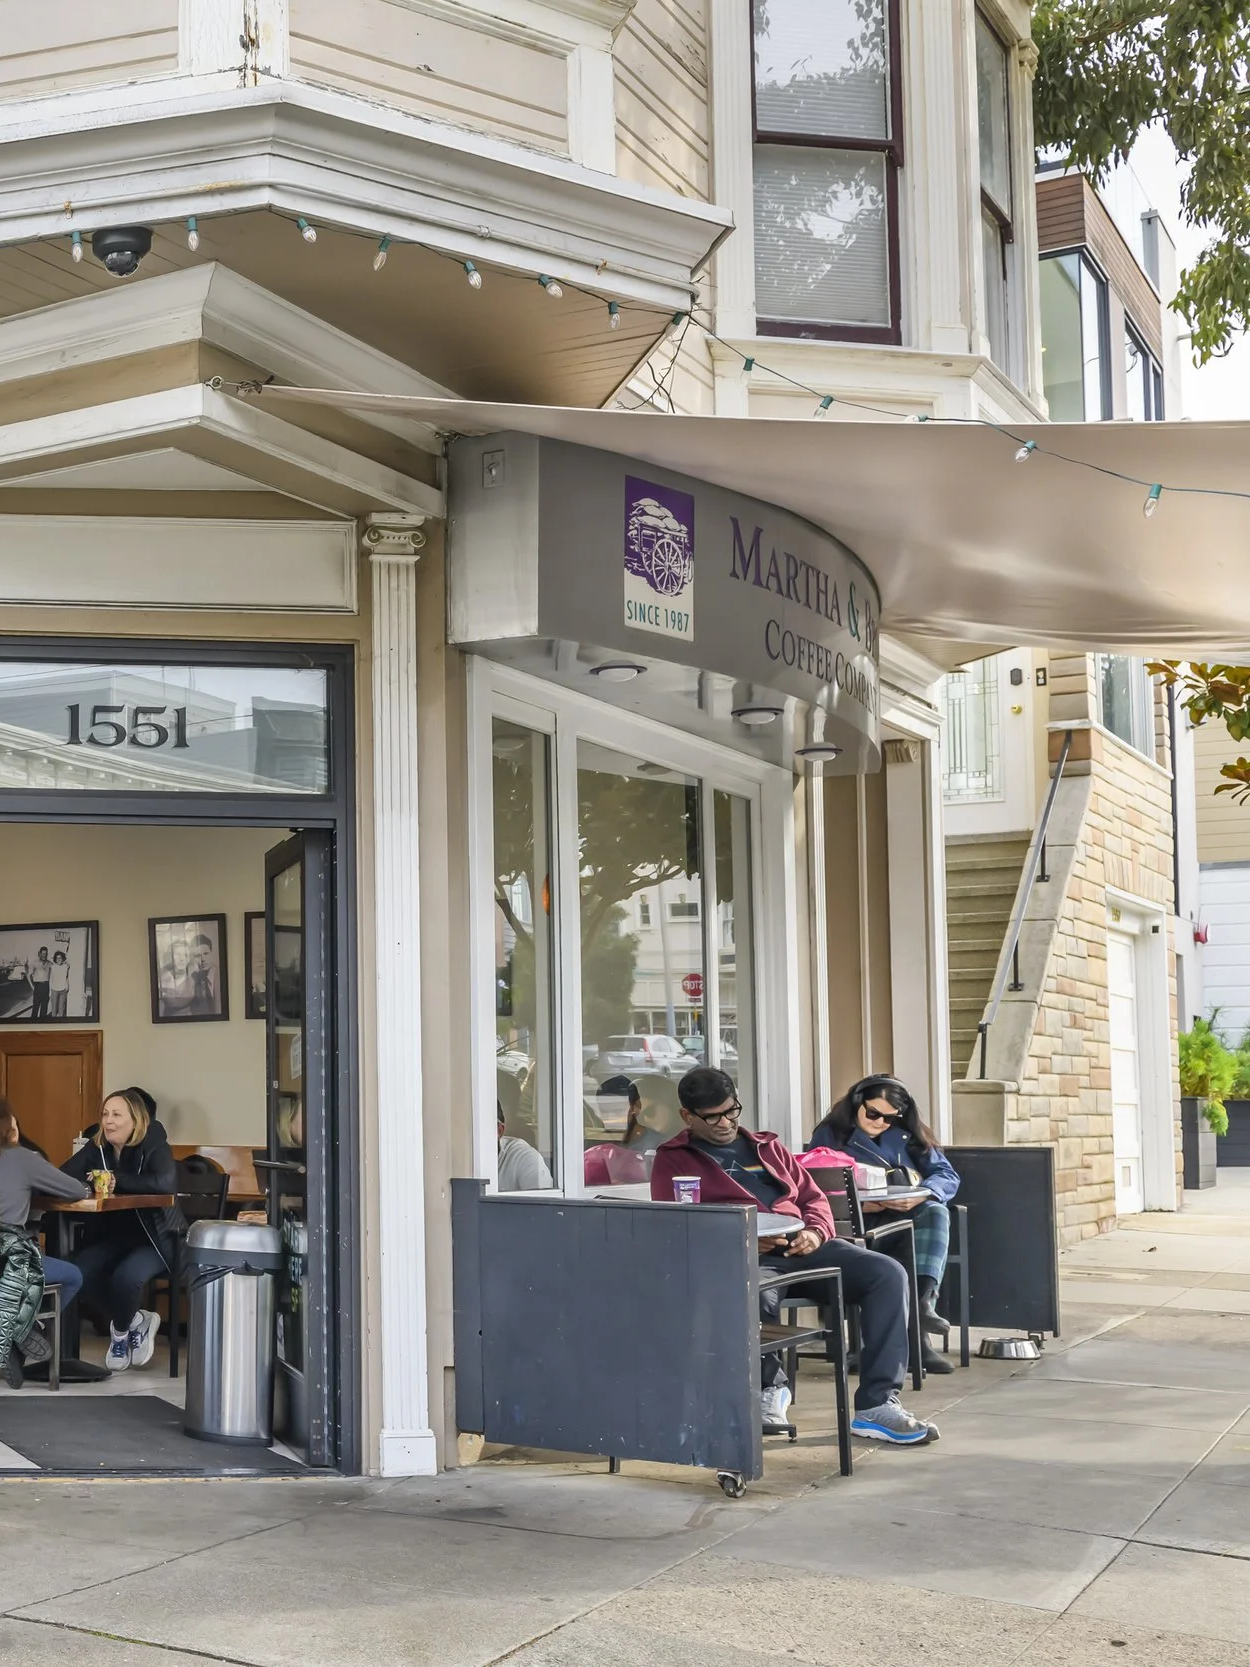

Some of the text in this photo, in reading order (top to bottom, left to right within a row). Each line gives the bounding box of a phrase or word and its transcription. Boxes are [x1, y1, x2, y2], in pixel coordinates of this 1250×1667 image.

[729, 515, 842, 627] MARTHA
[847, 581, 861, 642] &
[626, 600, 689, 633] SINCE 1987
[764, 619, 833, 684] COFFEE
[66, 703, 190, 749] 1551
